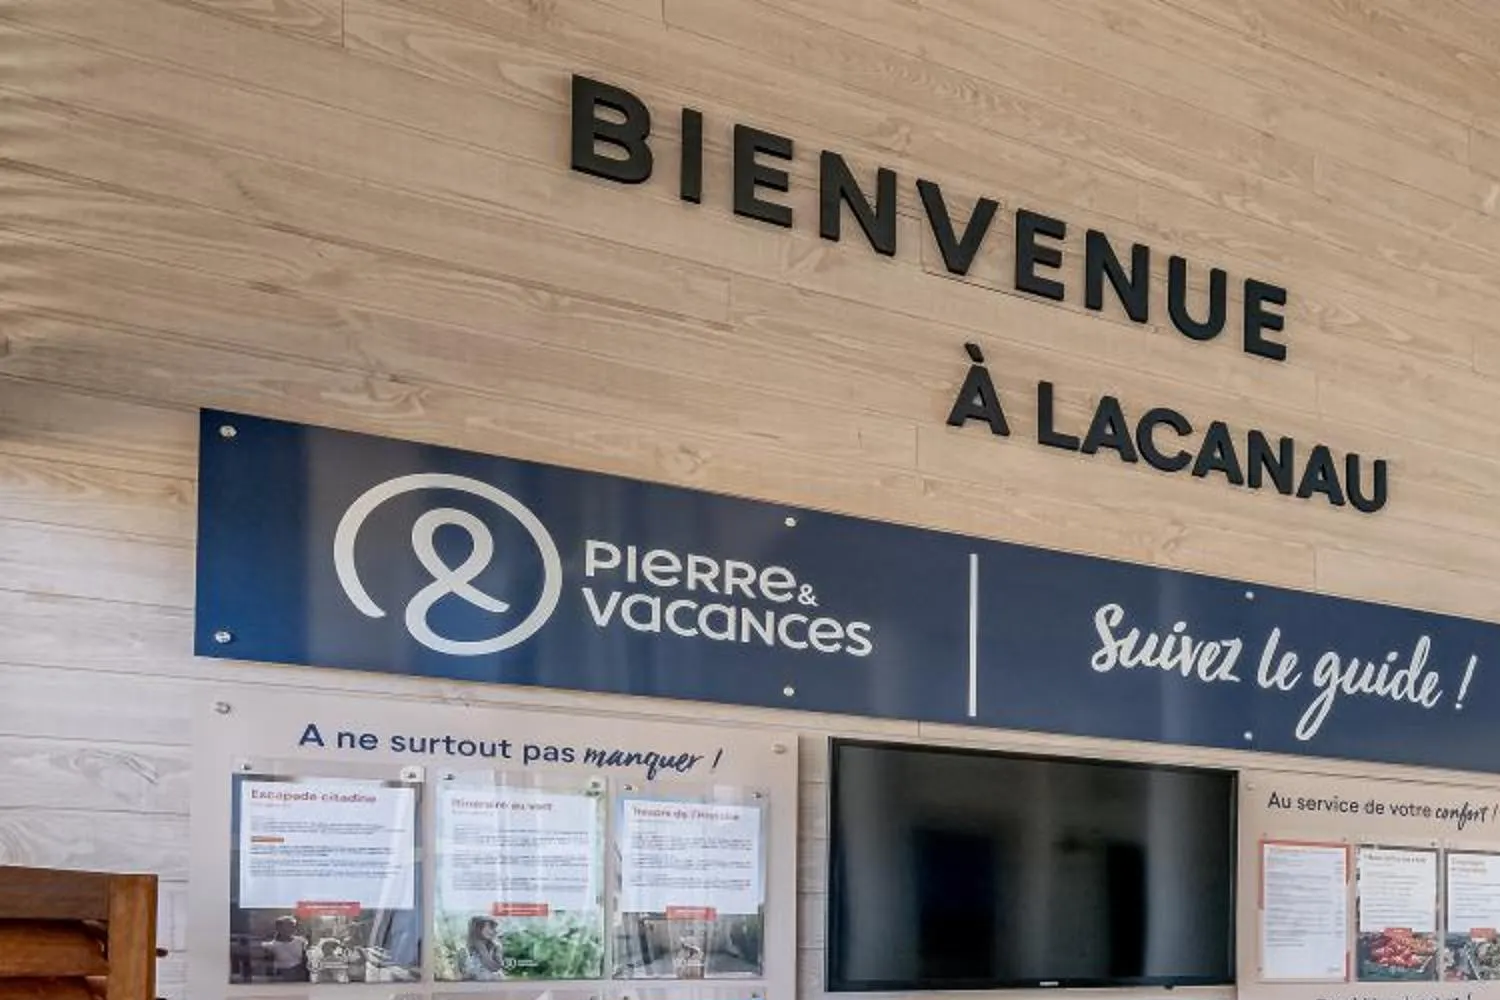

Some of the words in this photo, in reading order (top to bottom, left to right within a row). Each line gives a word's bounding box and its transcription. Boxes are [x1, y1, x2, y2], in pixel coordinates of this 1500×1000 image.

[571, 74, 1287, 361] BIENVENUE
[946, 343, 1009, 437] À
[1037, 382, 1387, 513] LACANAU
[1091, 604, 1242, 682] Suivez
[1257, 627, 1301, 691] le
[1295, 635, 1442, 740] guide
[299, 722, 325, 748] A
[337, 730, 378, 752] ne
[390, 732, 512, 760] surtout
[523, 742, 576, 768] pas
[583, 745, 704, 780] manquer
[1267, 792, 1291, 809] Au
[1297, 795, 1359, 813] service
[1365, 800, 1385, 815] de
[1390, 804, 1432, 818] votre
[1435, 801, 1488, 830] confort
